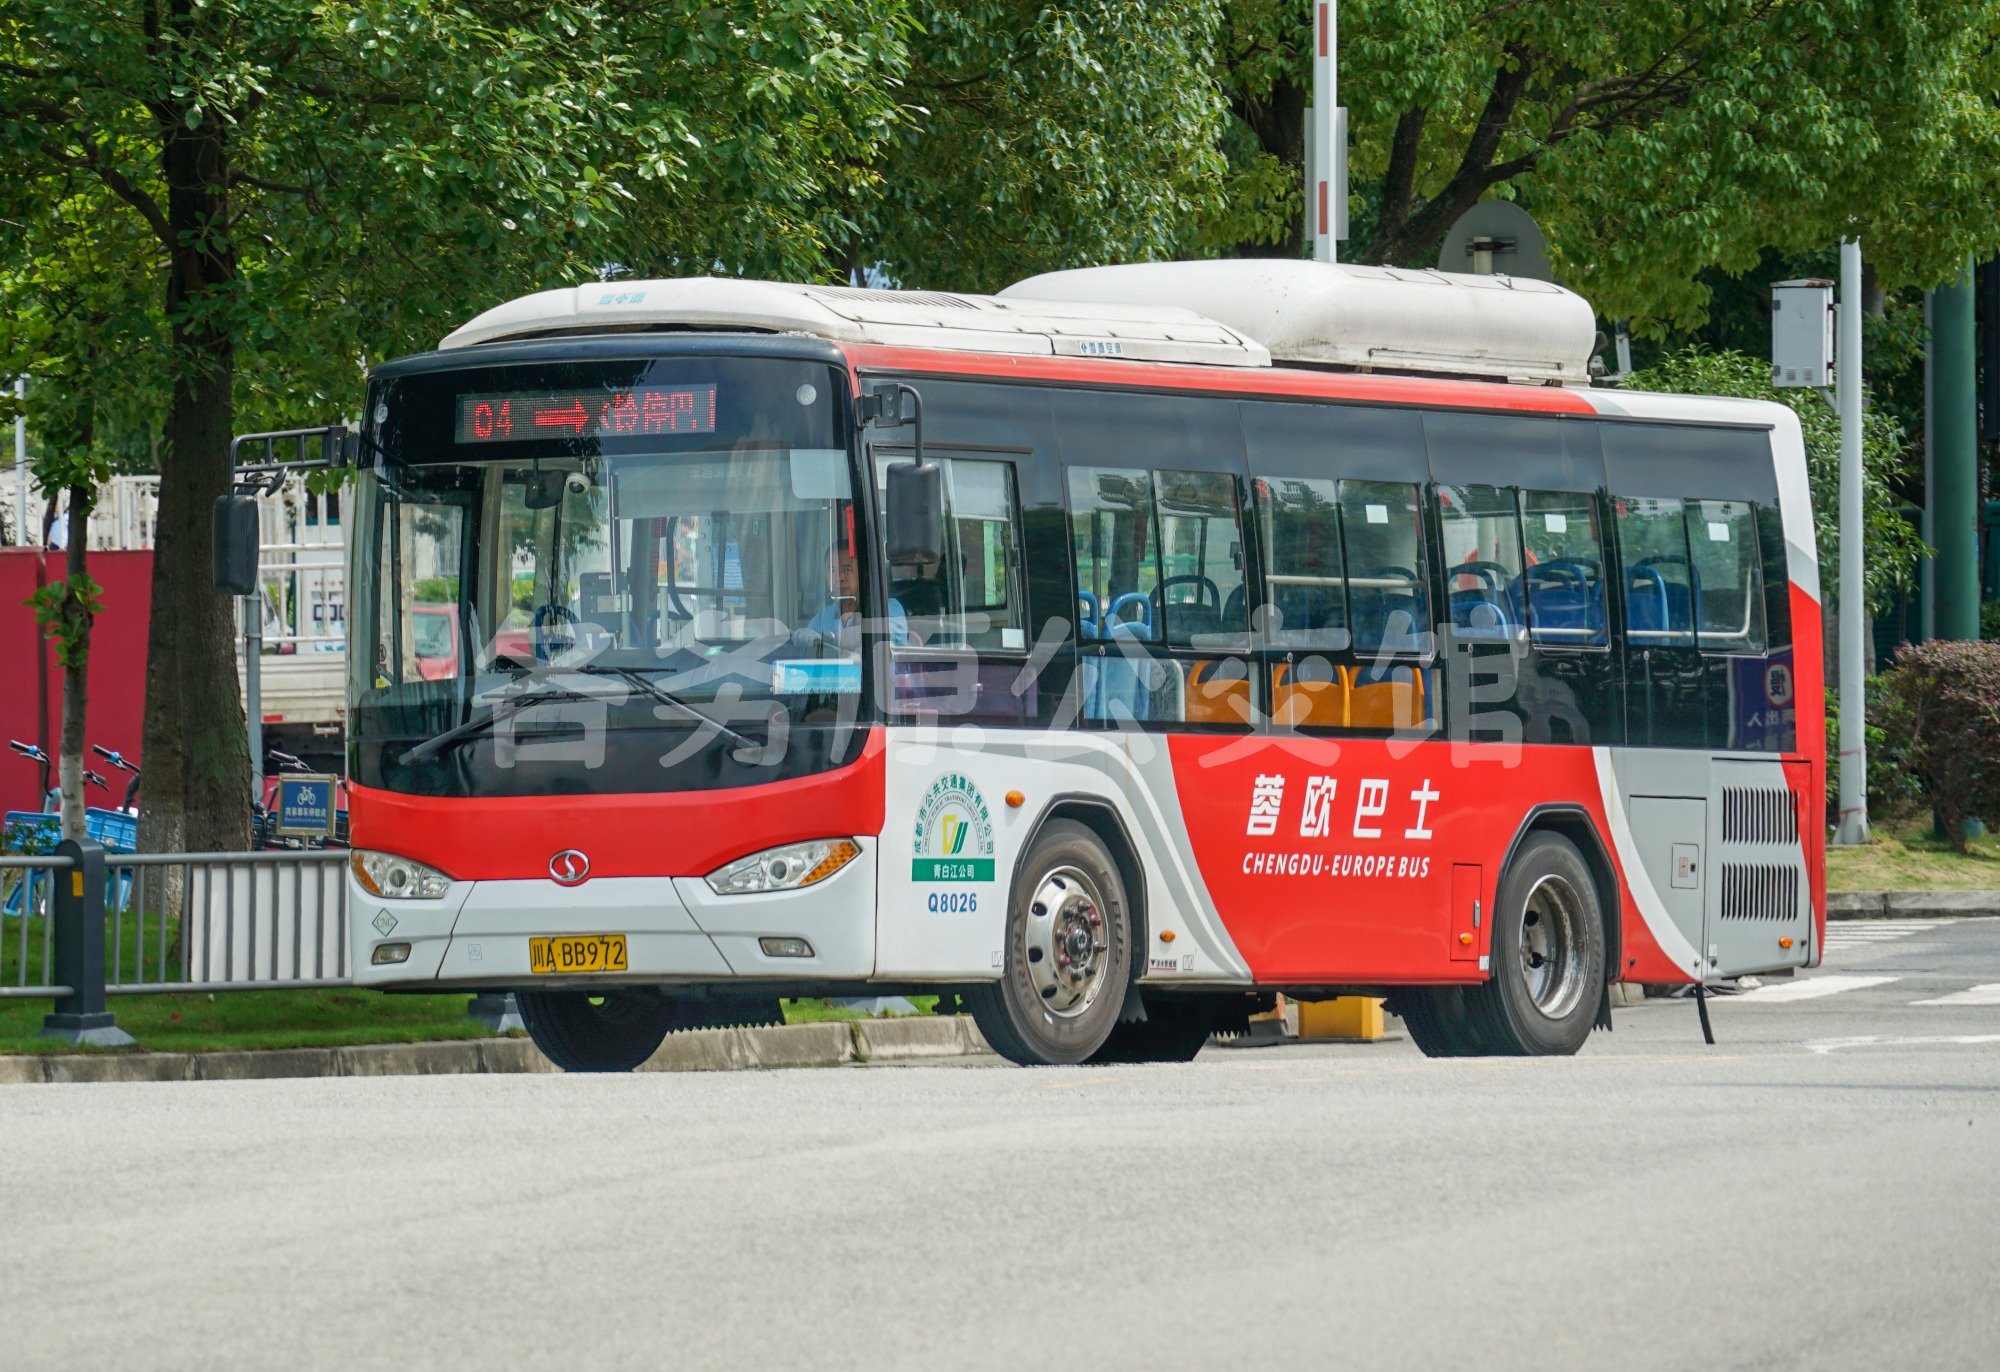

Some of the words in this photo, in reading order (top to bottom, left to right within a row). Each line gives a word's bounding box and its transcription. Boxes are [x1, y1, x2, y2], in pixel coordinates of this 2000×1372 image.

[914, 774, 993, 854] 成都市公共交通集团有限公司
[1246, 773, 1440, 840] 蓉欧巴士
[933, 864, 975, 879] 青白江公司
[1243, 853, 1395, 877] CHENGDU-EUROPE
[1397, 856, 1430, 878] BUS
[928, 892, 977, 914] Q8026
[376, 917, 394, 928] CNG
